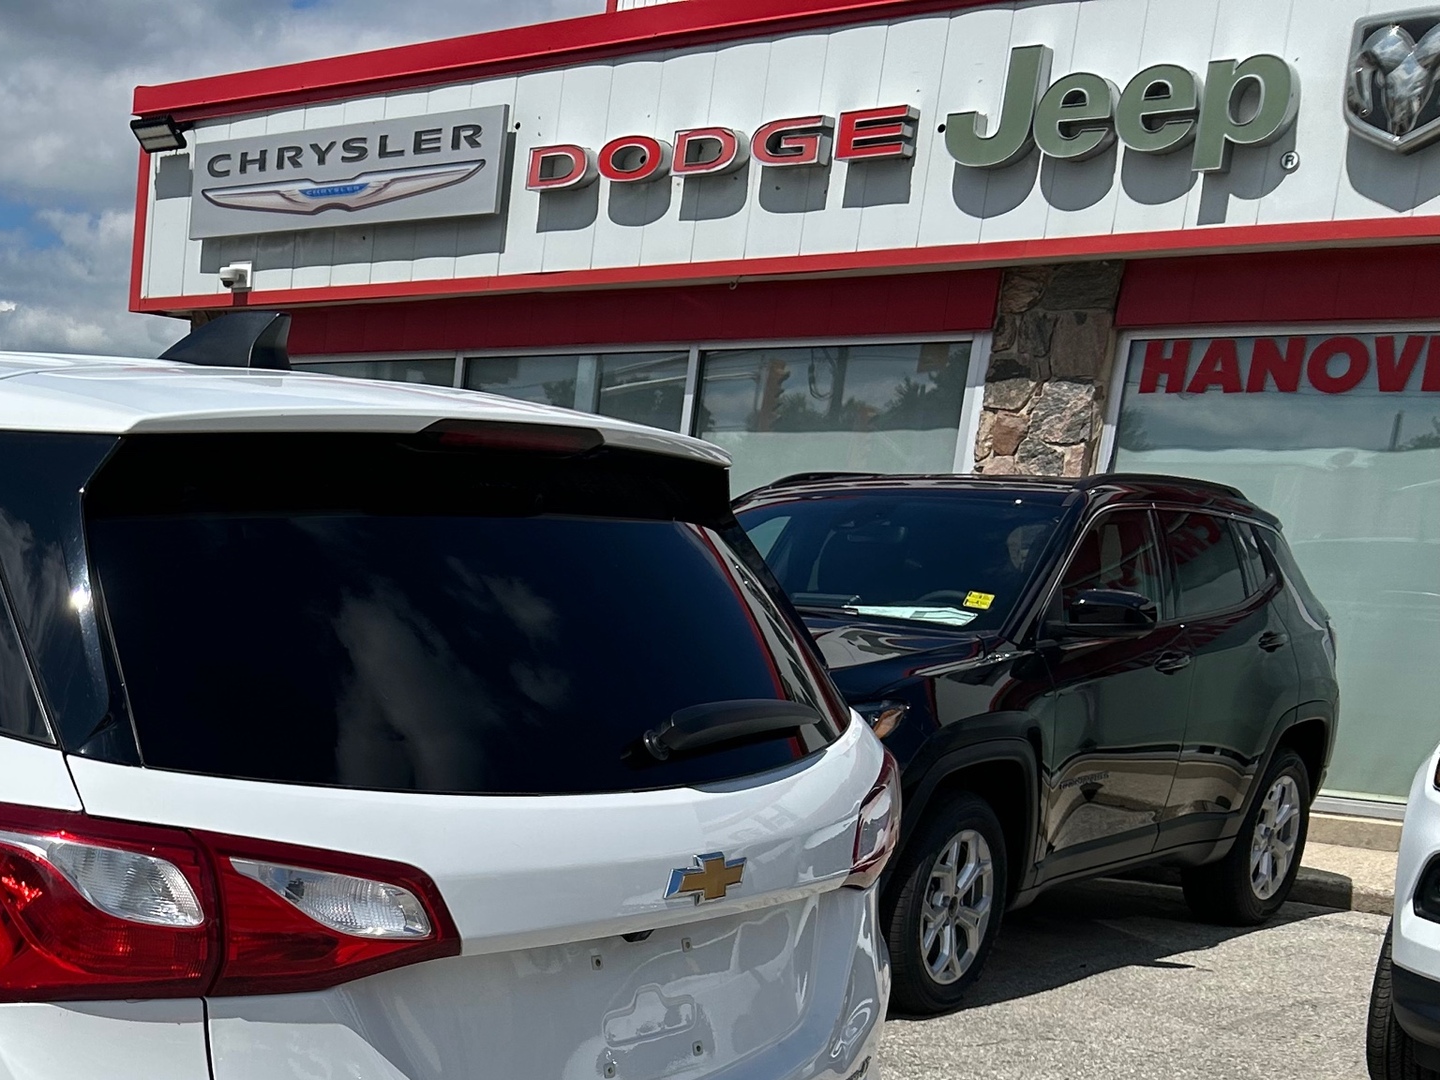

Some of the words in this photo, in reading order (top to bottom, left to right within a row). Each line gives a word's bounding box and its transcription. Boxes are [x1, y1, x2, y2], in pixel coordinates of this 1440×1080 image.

[945, 44, 1299, 173] Jeep
[207, 124, 484, 178] CHRYSLER
[525, 103, 915, 191] DODGE
[306, 185, 360, 196] CHRYSLER
